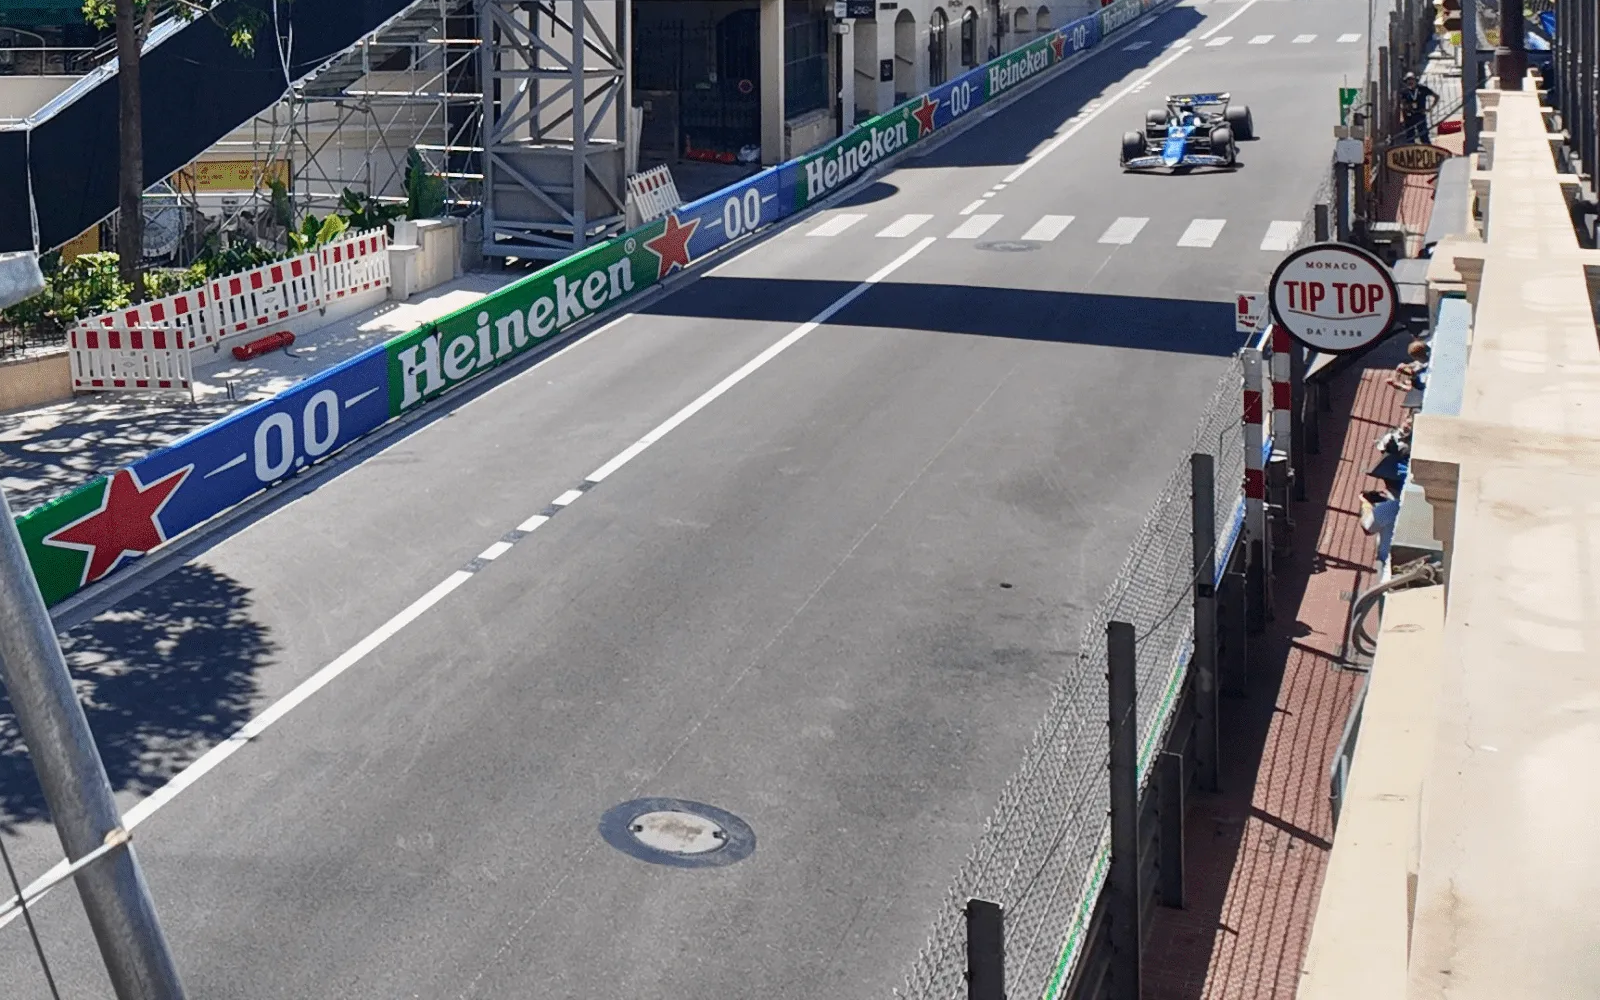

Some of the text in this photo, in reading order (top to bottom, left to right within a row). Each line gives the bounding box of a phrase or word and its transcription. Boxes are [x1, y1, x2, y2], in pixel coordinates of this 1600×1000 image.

[988, 47, 1049, 97] Heineken
[804, 120, 910, 201] Heineken
[723, 187, 761, 240] 0.0
[1305, 261, 1358, 271] MONACO
[1283, 280, 1384, 315] TIP TOP
[397, 255, 637, 410] Heineken
[253, 388, 340, 483] 0.0
